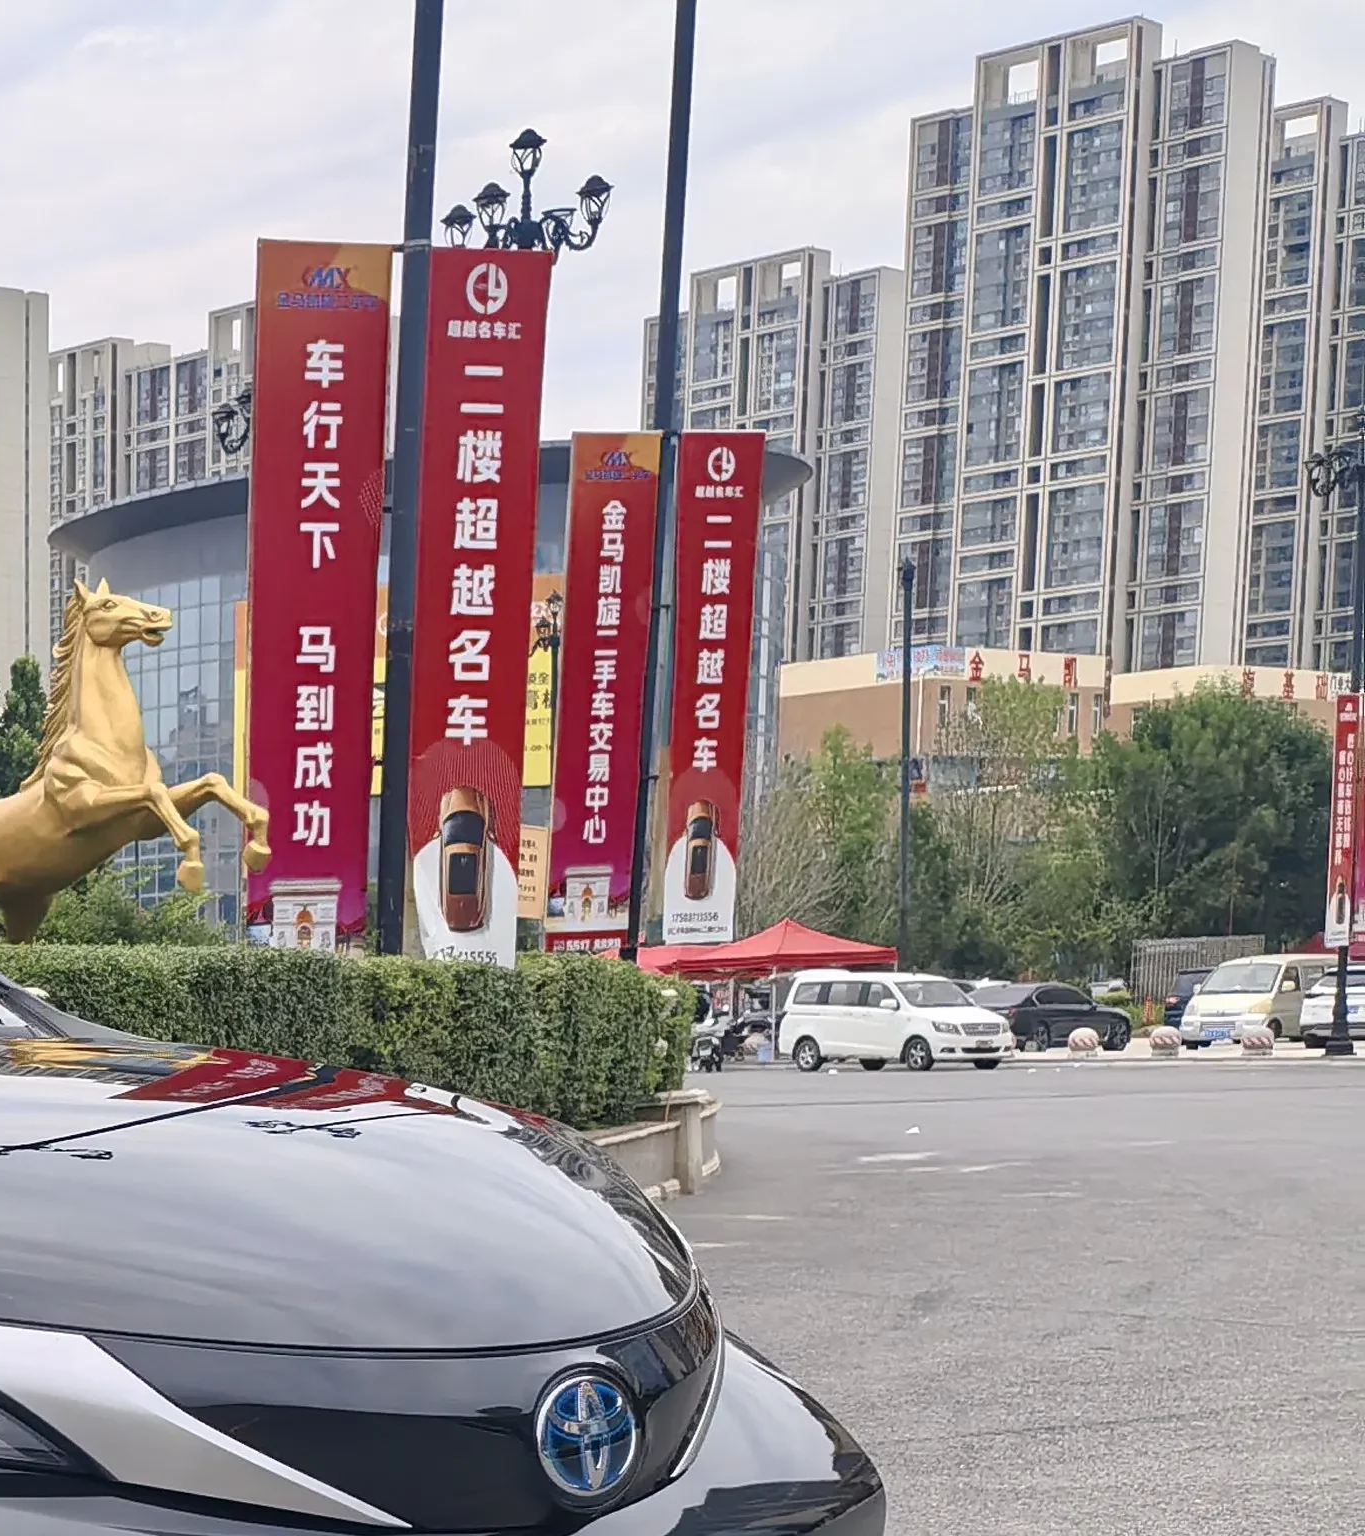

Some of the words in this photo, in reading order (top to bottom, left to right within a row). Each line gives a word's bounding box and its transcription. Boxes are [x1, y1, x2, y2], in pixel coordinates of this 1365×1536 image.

[299, 339, 345, 569] 车行天下
[443, 364, 504, 746] 二楼超越名车
[292, 625, 336, 847] 马到成功
[582, 500, 627, 843] 金马凯旋二手车交易中心
[692, 514, 733, 773] 二楼超越名车
